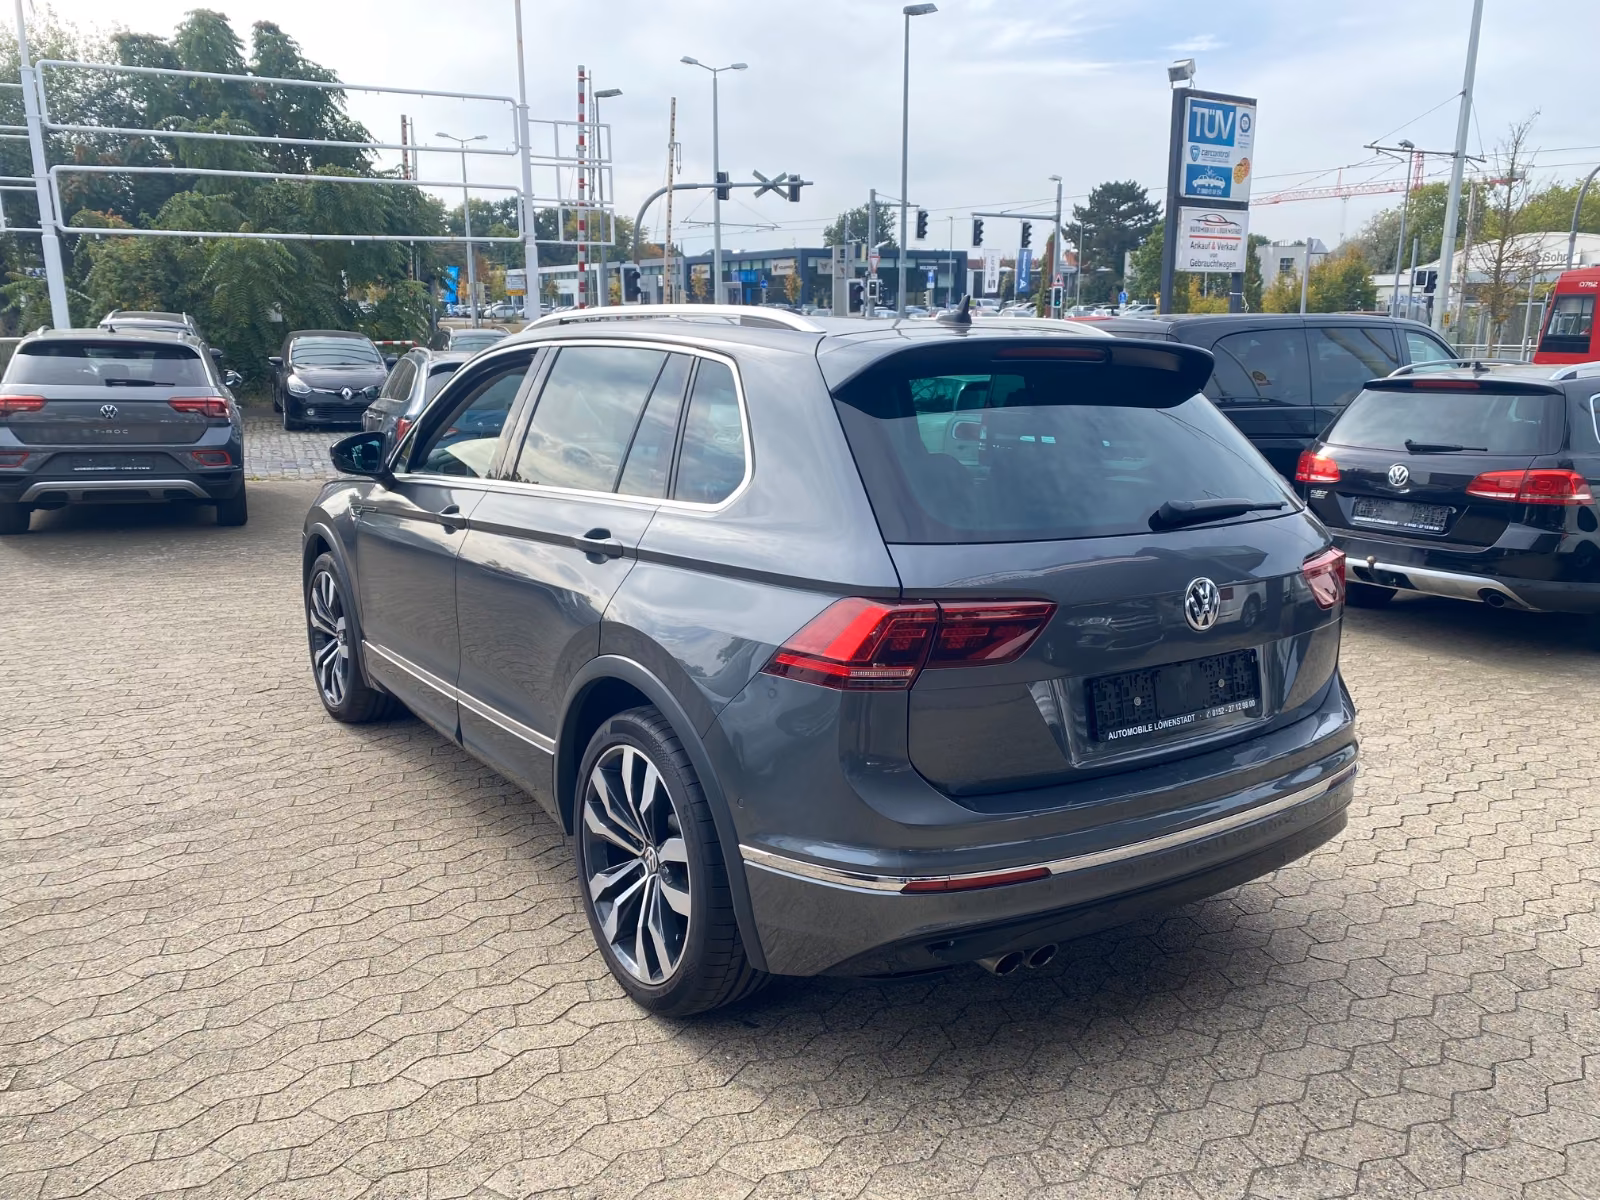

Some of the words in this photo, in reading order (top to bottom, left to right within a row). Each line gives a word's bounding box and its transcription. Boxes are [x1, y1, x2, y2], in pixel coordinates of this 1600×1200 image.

[1192, 106, 1234, 140] TÜV
[1190, 241, 1210, 250] Ankauf
[1217, 242, 1239, 251] Verkauf
[1190, 259, 1236, 270] Gebrauchtwagen
[1108, 725, 1153, 740] AUTOMOBILE
[1154, 714, 1195, 730] LÖWENSTADT
